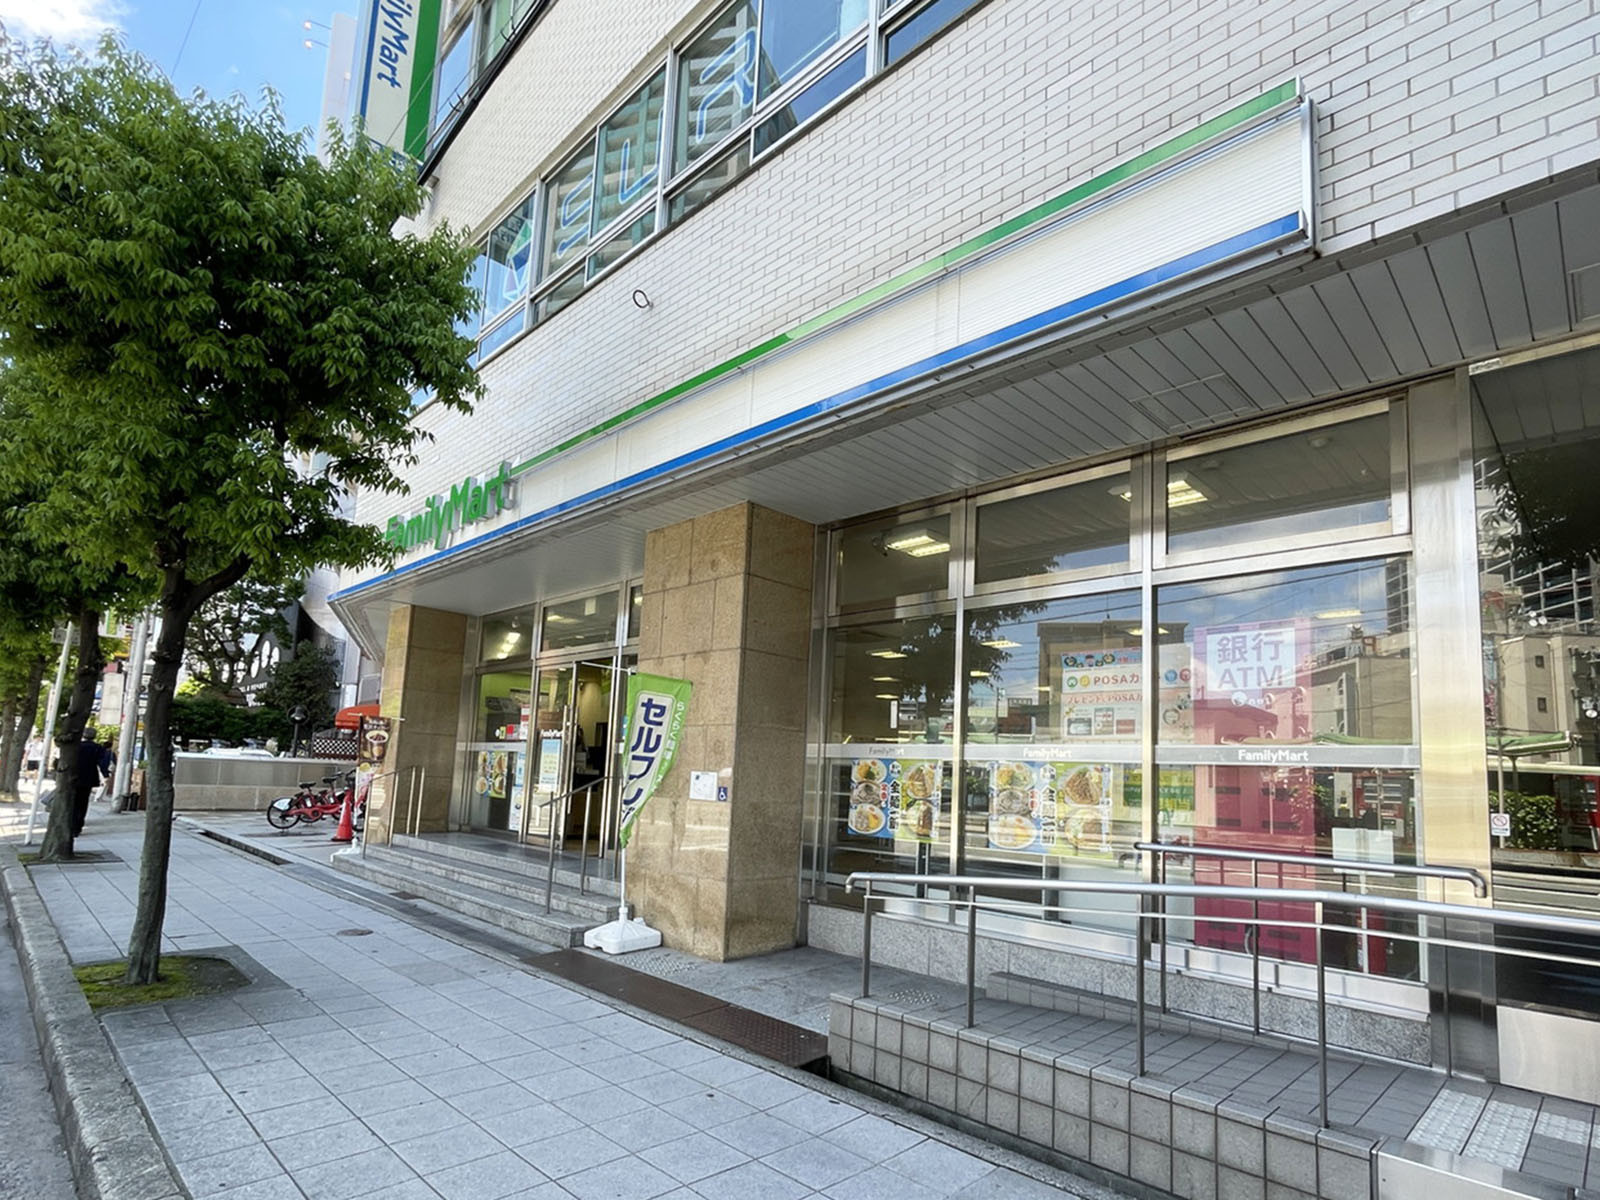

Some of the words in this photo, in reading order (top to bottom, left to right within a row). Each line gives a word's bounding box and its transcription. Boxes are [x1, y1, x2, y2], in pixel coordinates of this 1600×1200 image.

[385, 460, 512, 550] FamilyMart
[1217, 632, 1284, 664] 銀行
[1217, 665, 1282, 689] ATM
[1238, 749, 1309, 763] FamilyMart
